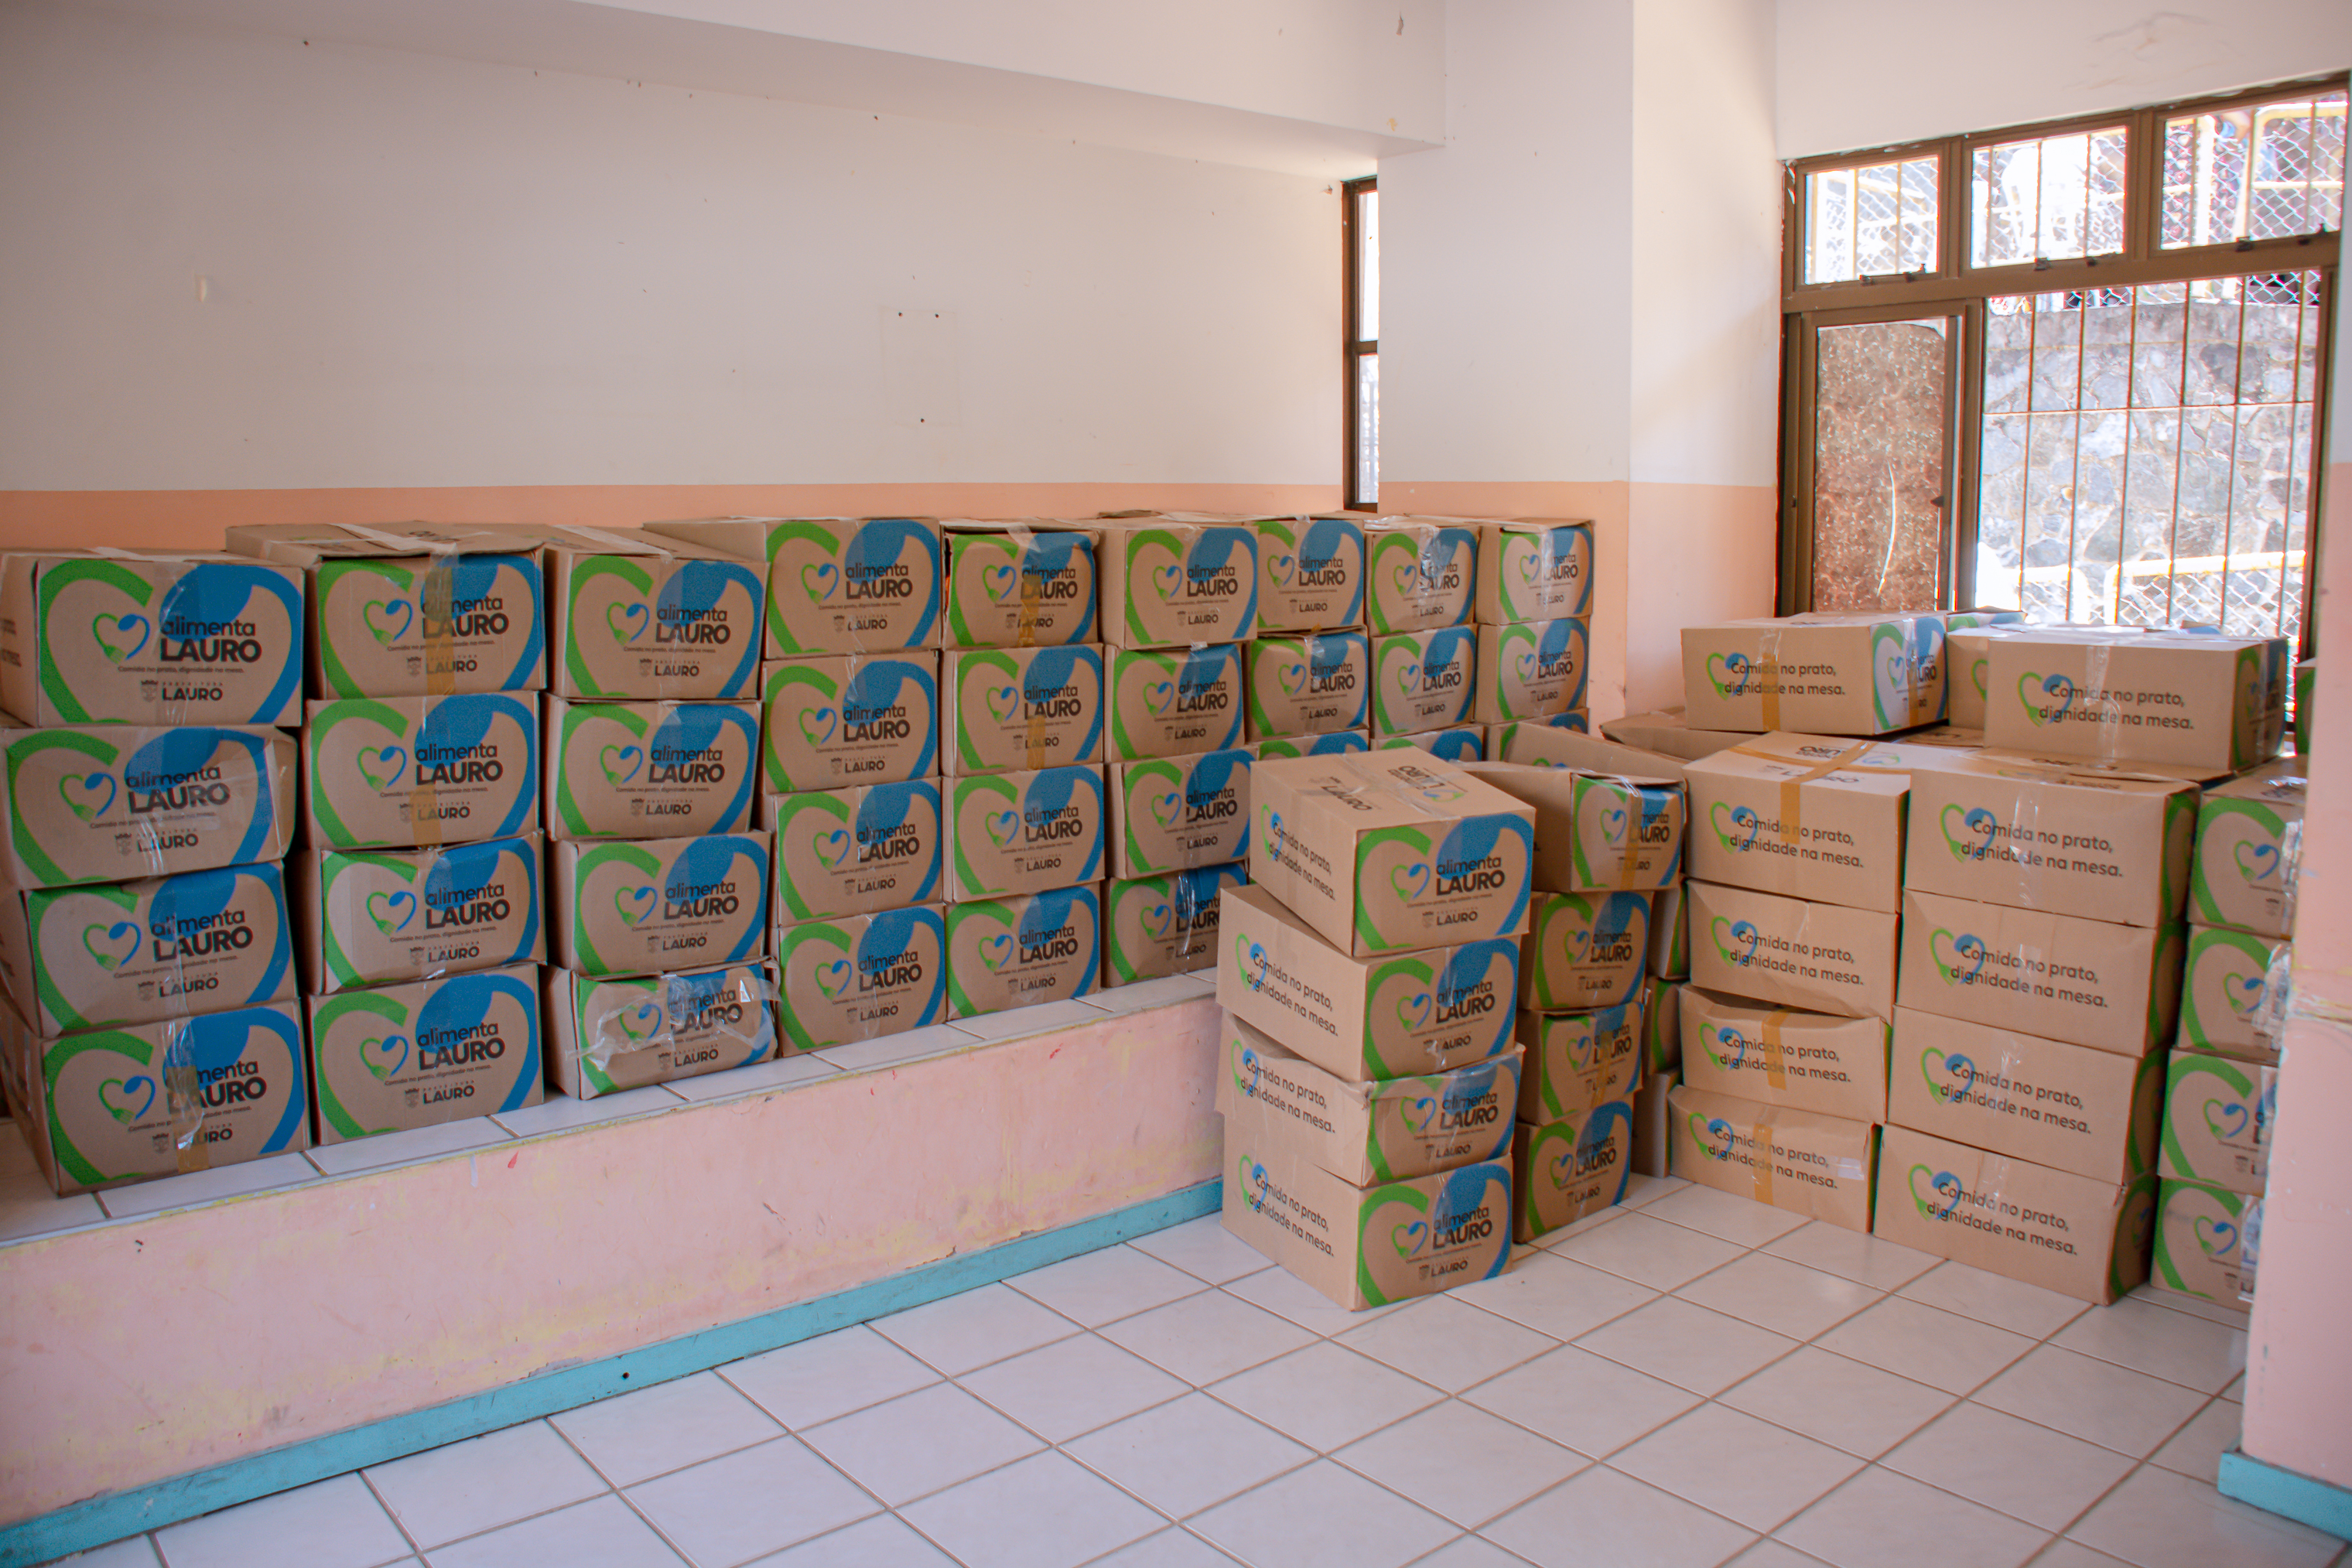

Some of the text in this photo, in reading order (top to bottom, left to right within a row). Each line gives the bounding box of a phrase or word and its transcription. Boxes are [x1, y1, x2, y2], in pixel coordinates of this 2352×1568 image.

[845, 562, 908, 578] alimenta
[1187, 564, 1236, 578] alimenta
[1298, 555, 1343, 568] alimenta
[1187, 578, 1239, 596] LAURO
[1299, 569, 1346, 586] LAURO
[846, 578, 914, 600] LAURO
[657, 603, 728, 622] alimenta
[1300, 603, 1328, 612] LAURO
[160, 615, 256, 637] alimenta
[422, 613, 510, 639] LAURO
[848, 619, 888, 631] LAURO
[1188, 614, 1219, 624] LAURO
[655, 623, 731, 644] LAURO
[161, 637, 262, 663] LAURO
[1538, 650, 1572, 662] alimenta
[426, 659, 477, 674] LAURO
[655, 664, 700, 677] LAURO
[1310, 661, 1354, 675] alimenta
[1423, 661, 1460, 674] alimenta
[1537, 661, 1574, 678] LAURO
[1178, 681, 1227, 694] alimenta
[1423, 671, 1461, 691] LAURO
[162, 687, 223, 701] LAURO
[1024, 684, 1078, 699] alimenta
[843, 704, 907, 720] alimenta
[1024, 698, 1082, 719] LAURO
[1177, 693, 1229, 712] LAURO
[1310, 708, 1338, 719] LAURO
[843, 719, 911, 742] LAURO
[1175, 728, 1207, 740] LAURO
[415, 743, 497, 761] alimenta
[651, 745, 723, 761] alimenta
[126, 766, 220, 787] alimenta
[416, 760, 504, 785] LAURO
[648, 764, 726, 784] LAURO
[846, 760, 886, 773] LAURO
[128, 783, 230, 814] LAURO
[1185, 787, 1235, 803] alimenta
[419, 805, 471, 821] LAURO
[647, 804, 692, 815] LAURO
[1024, 805, 1079, 822] alimenta
[1186, 799, 1239, 822] LAURO
[856, 822, 916, 842] alimenta
[1024, 819, 1083, 842] LAURO
[1971, 819, 2113, 853] Comida no prato,
[856, 836, 921, 863] LAURO
[1273, 823, 1332, 875] Comida no prato,
[1027, 858, 1061, 871] LAURO
[1269, 841, 1335, 900] dignidade na mesa.
[1436, 856, 1502, 874] alimenta
[2046, 857, 2067, 869] na
[2071, 860, 2123, 877] mesa.
[665, 881, 737, 898] alimenta
[858, 878, 897, 893] LAURO
[1436, 869, 1506, 896] LAURO
[426, 883, 505, 904] alimenta
[426, 900, 511, 928] LAURO
[664, 896, 740, 920] LAURO
[1438, 910, 1479, 925] LAURO
[151, 910, 245, 935] alimenta
[153, 926, 254, 961] LAURO
[663, 937, 708, 951] LAURO
[1019, 926, 1075, 945] alimenta
[428, 946, 480, 963] LAURO
[1020, 938, 1079, 964] LAURO
[1737, 931, 1854, 964] Comida no prato,
[858, 950, 918, 971] alimenta
[1729, 949, 1864, 986] dignidade na mesa.
[1961, 945, 2098, 984] Comida no prato,
[159, 977, 219, 997] LAURO
[859, 964, 923, 992] LAURO
[1020, 976, 1057, 992] LAURO
[1253, 953, 1333, 1010] Comida no prato,
[1950, 965, 2108, 1008] dignidade na mesa.
[860, 1005, 899, 1021] LAURO
[1246, 972, 1338, 1037] dignidade na mesa.
[1436, 994, 1496, 1023] LAURO
[418, 1023, 499, 1047] alimenta
[1436, 1035, 1472, 1052] AURO
[419, 1037, 506, 1071] LAURO
[675, 1048, 720, 1067] LAURO
[423, 1085, 475, 1104] LAURO
[1951, 1064, 2083, 1109] Comida no prato,
[1441, 1091, 1499, 1109] alimenta
[1940, 1084, 2092, 1133] dignidade na mesa.
[1439, 1106, 1499, 1129] LAURO
[1438, 1145, 1472, 1158] LAURO
[1255, 1174, 1328, 1232] Comida no prato,
[1248, 1192, 1333, 1257] dignidade na mesa.
[1432, 1208, 1491, 1230] alimenta
[2000, 1202, 2019, 1215] no
[2022, 1208, 2069, 1232] prato,
[1432, 1220, 1493, 1249] LAURO
[1926, 1201, 2077, 1256] dignidade na mesa.
[1432, 1260, 1468, 1278] LAURO
